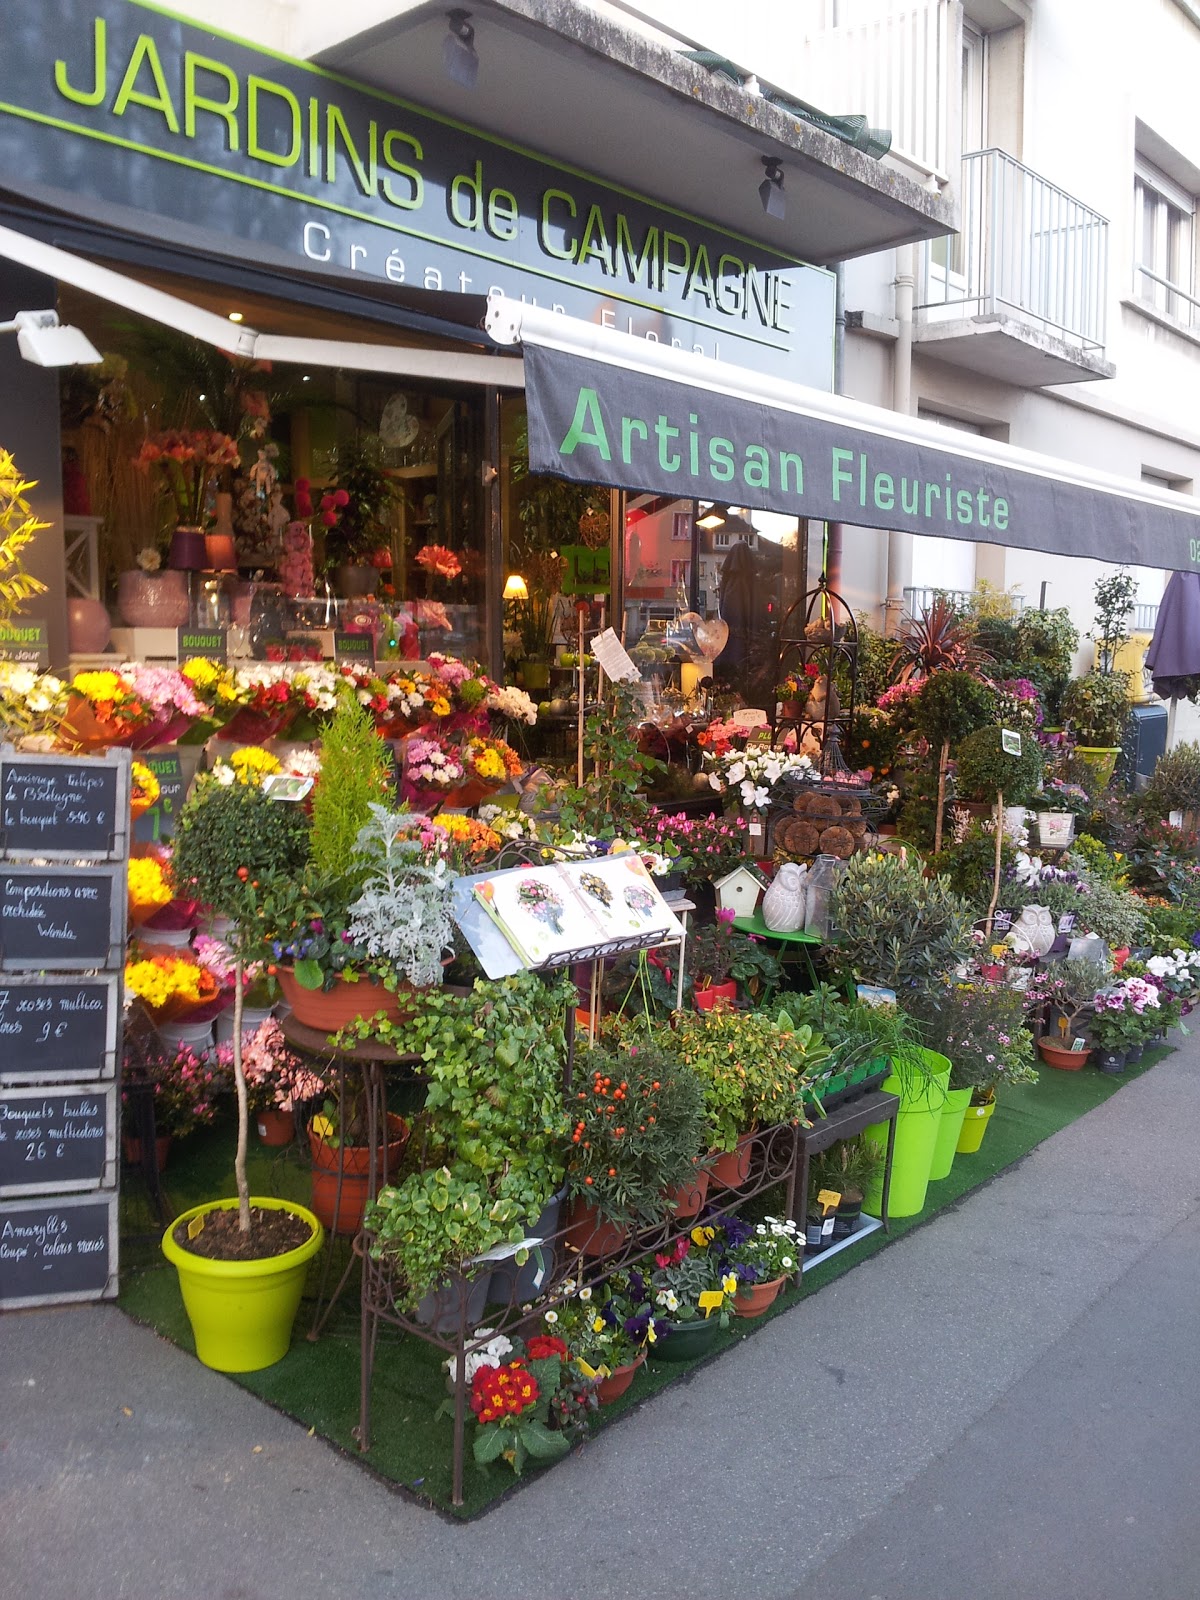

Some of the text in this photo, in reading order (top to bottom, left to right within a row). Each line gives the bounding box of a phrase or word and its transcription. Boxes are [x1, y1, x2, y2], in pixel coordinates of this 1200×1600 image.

[55, 17, 797, 334] JARDINS de CAMPAGNE
[559, 387, 1009, 530] Artisan Fleuriste
[182, 635, 222, 648] BOUQUET
[338, 640, 369, 650] BOUQUET
[20, 807, 59, 832] bouquet
[5, 878, 98, 903] Compositions avec
[37, 920, 77, 940] Wanda
[25, 1141, 47, 1160] 26
[1, 1214, 68, 1246] Amaryllis
